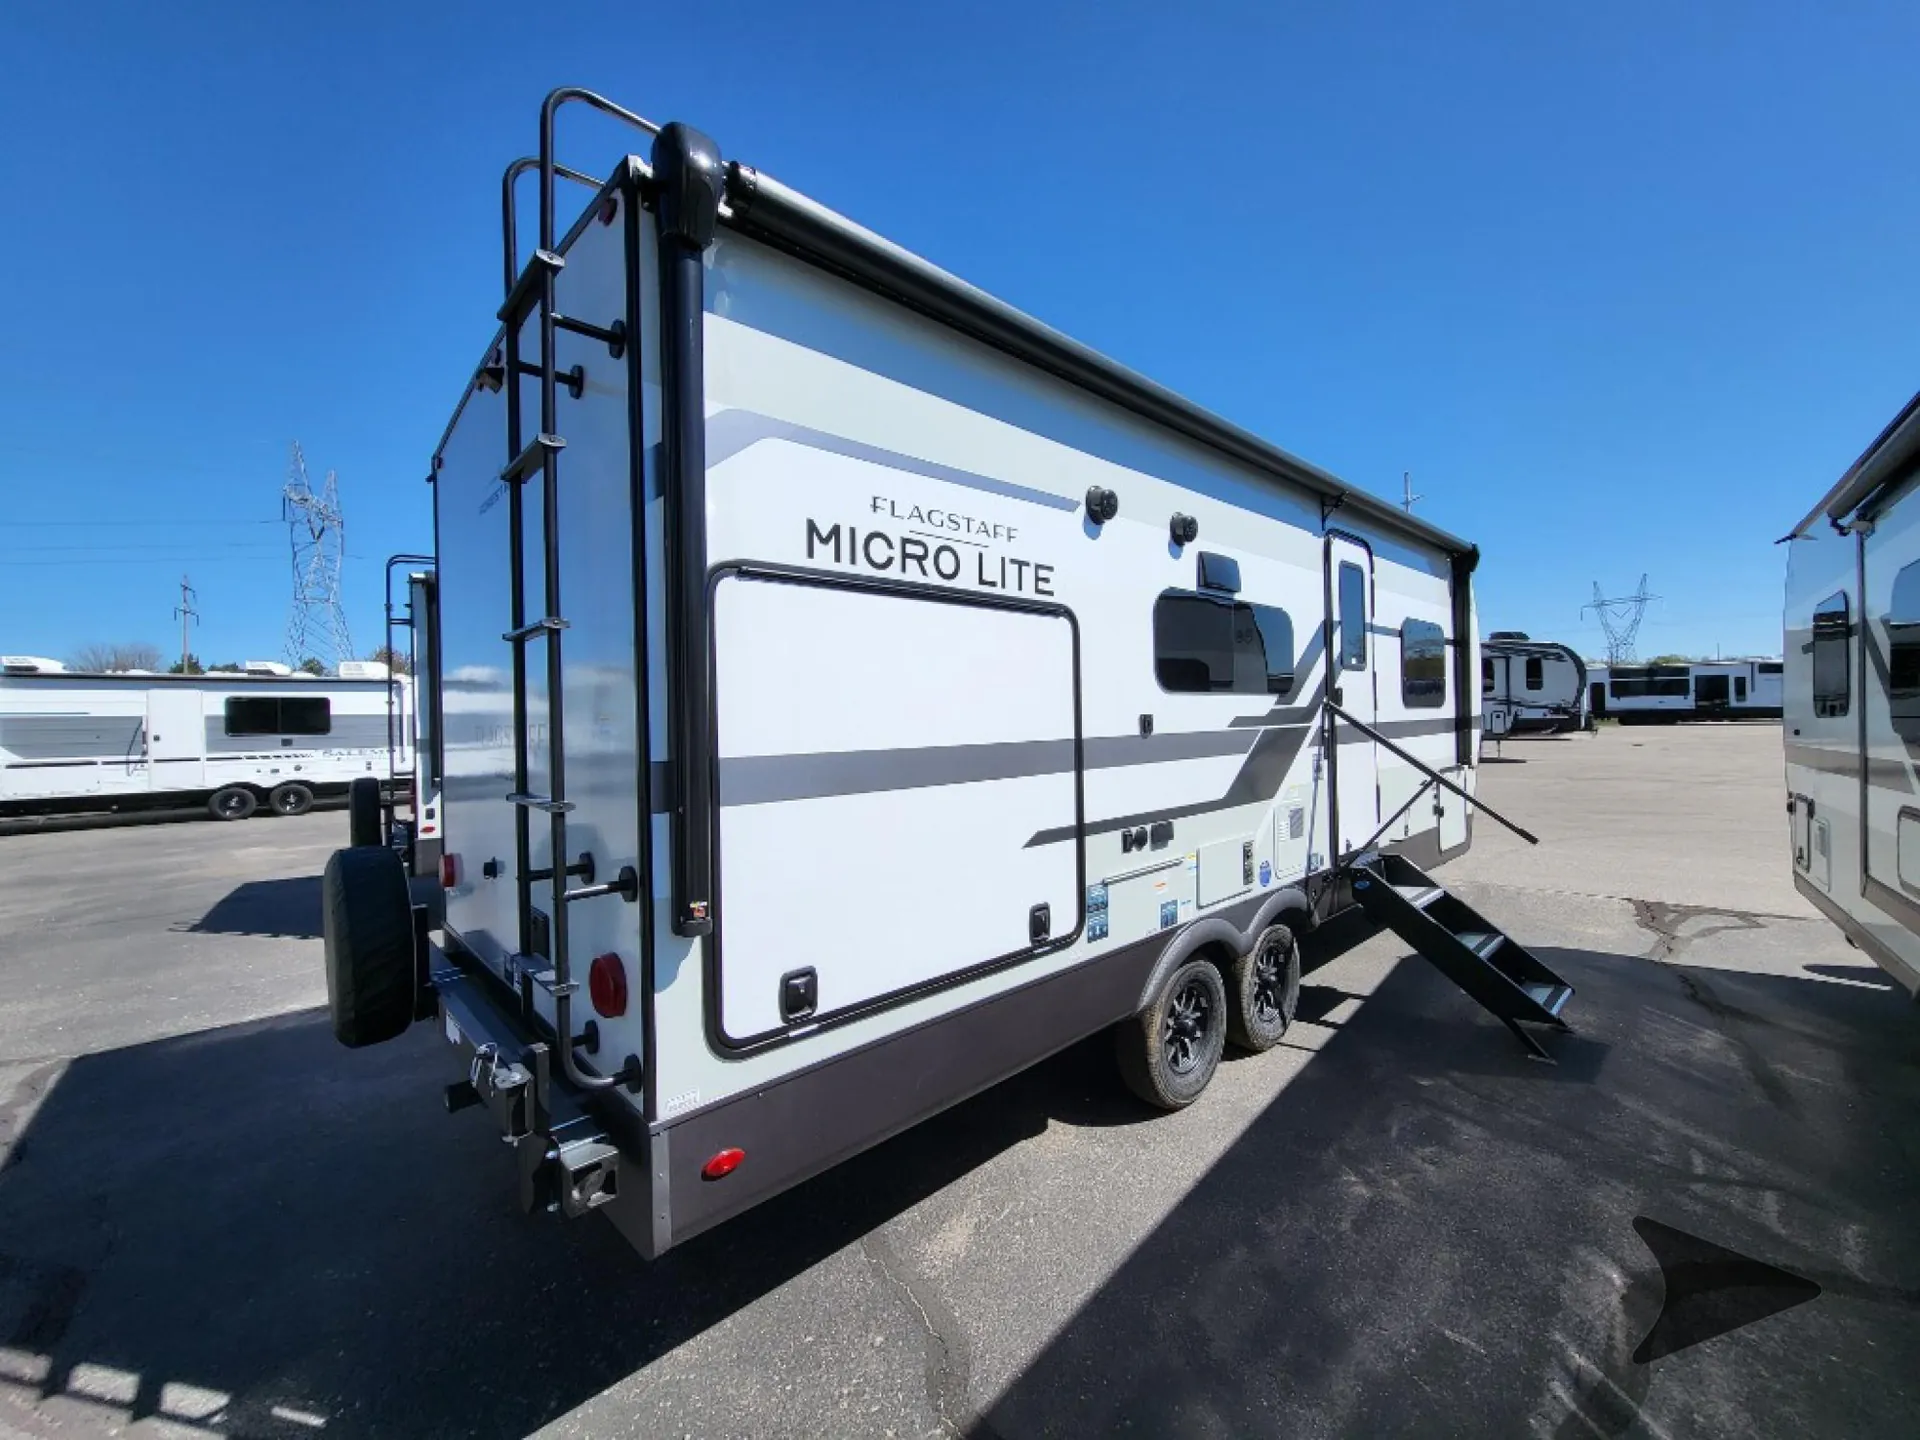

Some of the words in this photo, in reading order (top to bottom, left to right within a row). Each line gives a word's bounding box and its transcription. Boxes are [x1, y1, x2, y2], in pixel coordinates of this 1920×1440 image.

[870, 496, 1018, 542] FLAGSTAFF
[806, 518, 961, 581] MICRO
[978, 551, 1055, 597] LITE
